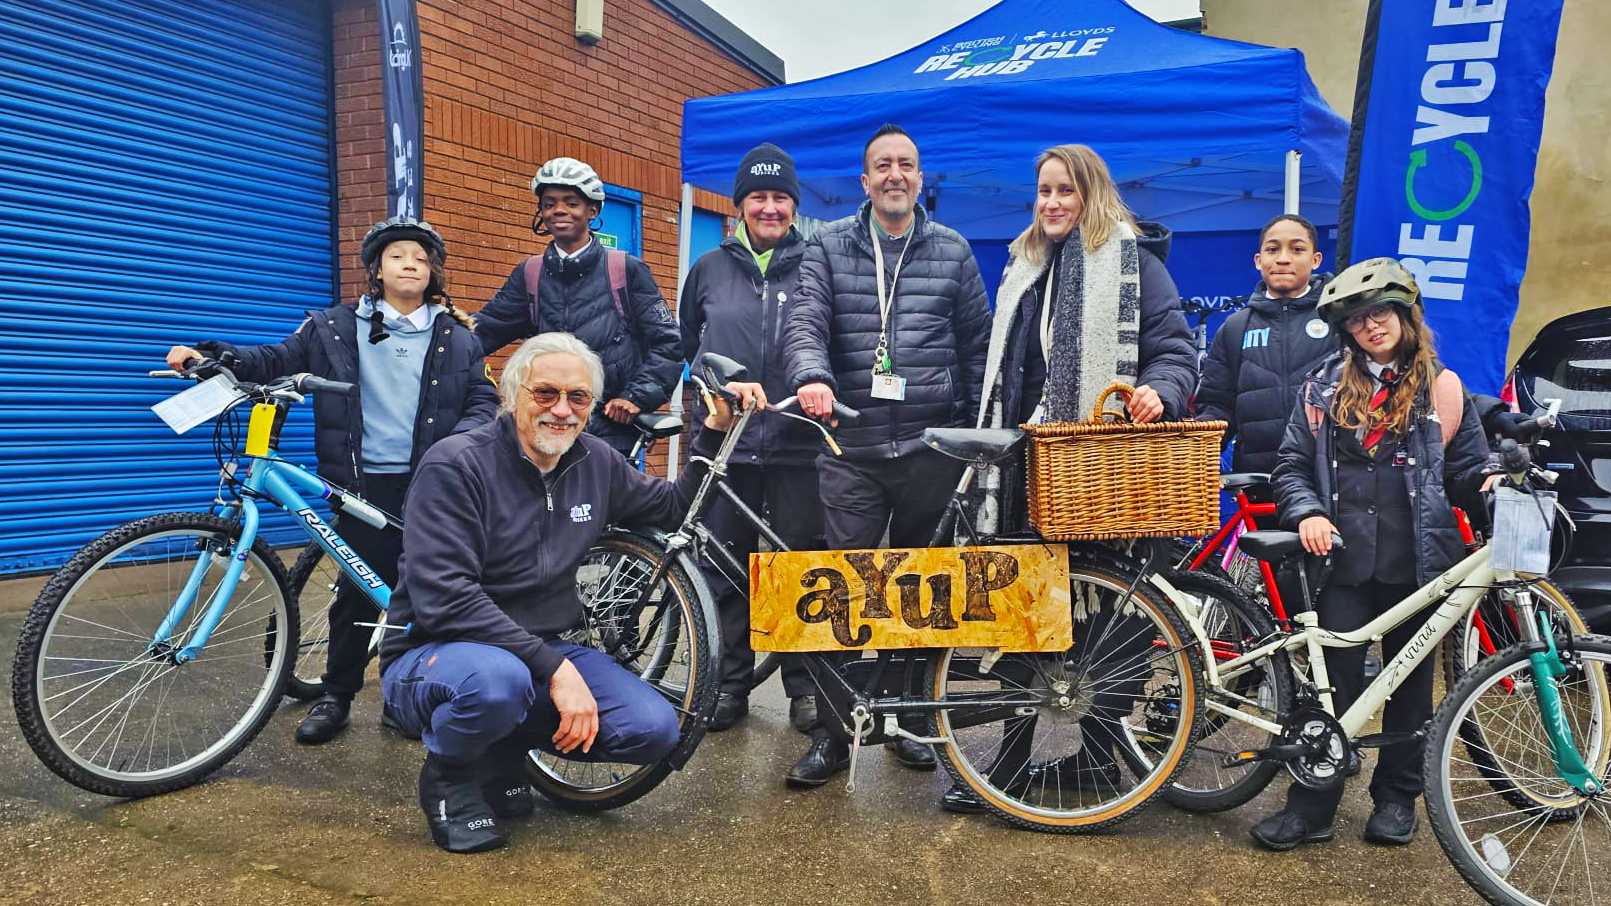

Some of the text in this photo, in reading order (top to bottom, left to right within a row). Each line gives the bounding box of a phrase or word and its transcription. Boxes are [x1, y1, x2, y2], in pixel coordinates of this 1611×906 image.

[1051, 26, 1116, 39] LLOYDS
[913, 37, 1109, 74] RECYCLE
[943, 59, 1035, 81] HUB
[1242, 327, 1271, 350] ITY
[297, 507, 384, 589] RALEIGH
[467, 818, 494, 828] GORE
